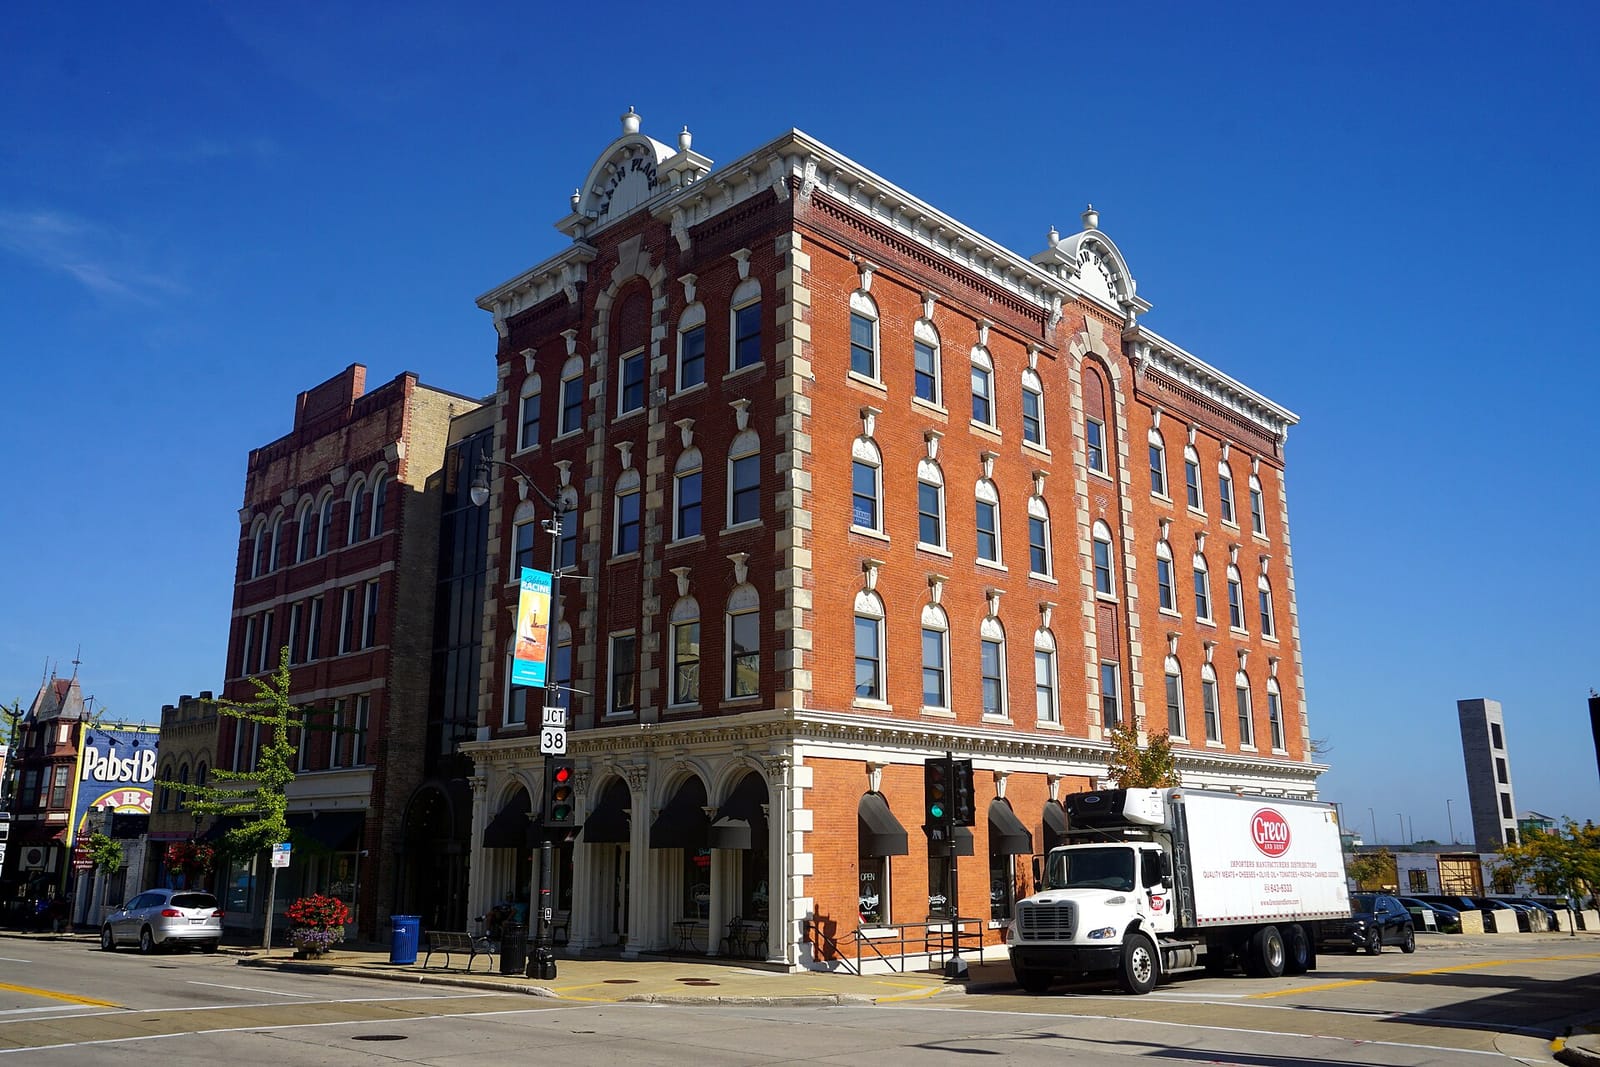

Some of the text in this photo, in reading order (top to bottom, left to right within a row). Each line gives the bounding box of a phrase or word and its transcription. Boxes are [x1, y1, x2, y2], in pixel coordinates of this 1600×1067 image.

[600, 158, 658, 215] MAIN PLACE
[544, 709, 564, 723] JCT
[543, 732, 563, 749] 38
[82, 746, 158, 783] Pabst B
[1253, 817, 1287, 844] Greco
[1203, 870, 1221, 879] QUALITY
[1239, 870, 1256, 878] CHEESES
